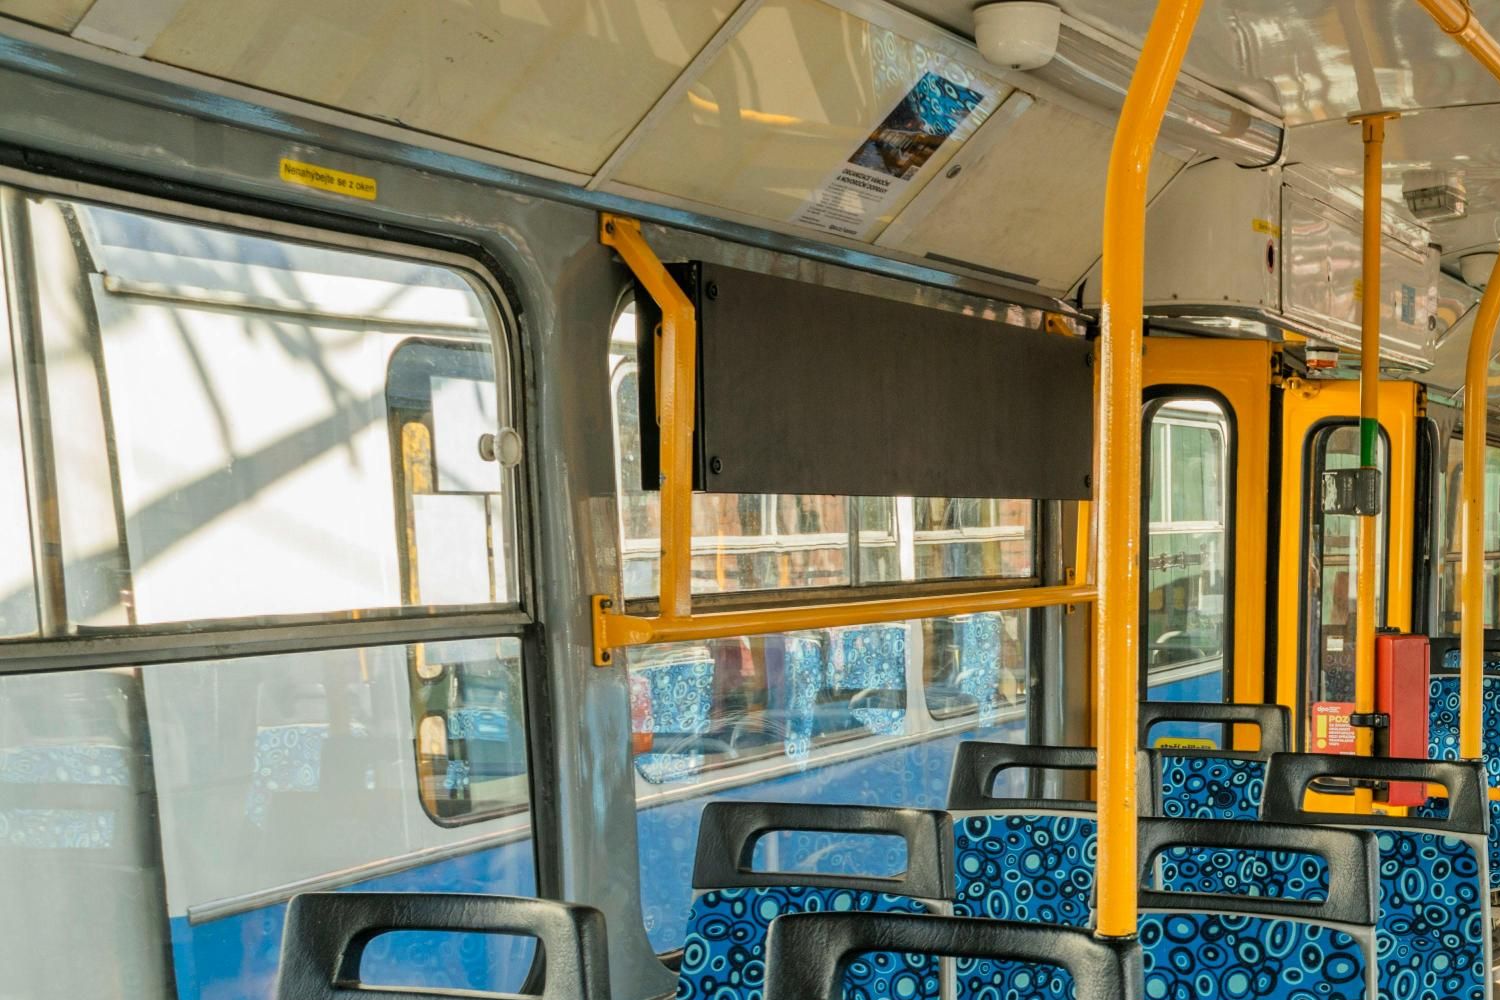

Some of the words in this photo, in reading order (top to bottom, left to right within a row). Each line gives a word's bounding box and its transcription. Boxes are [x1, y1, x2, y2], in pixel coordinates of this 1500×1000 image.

[337, 178, 346, 187] se
[356, 182, 375, 192] oken
[1329, 715, 1349, 723] POZ
